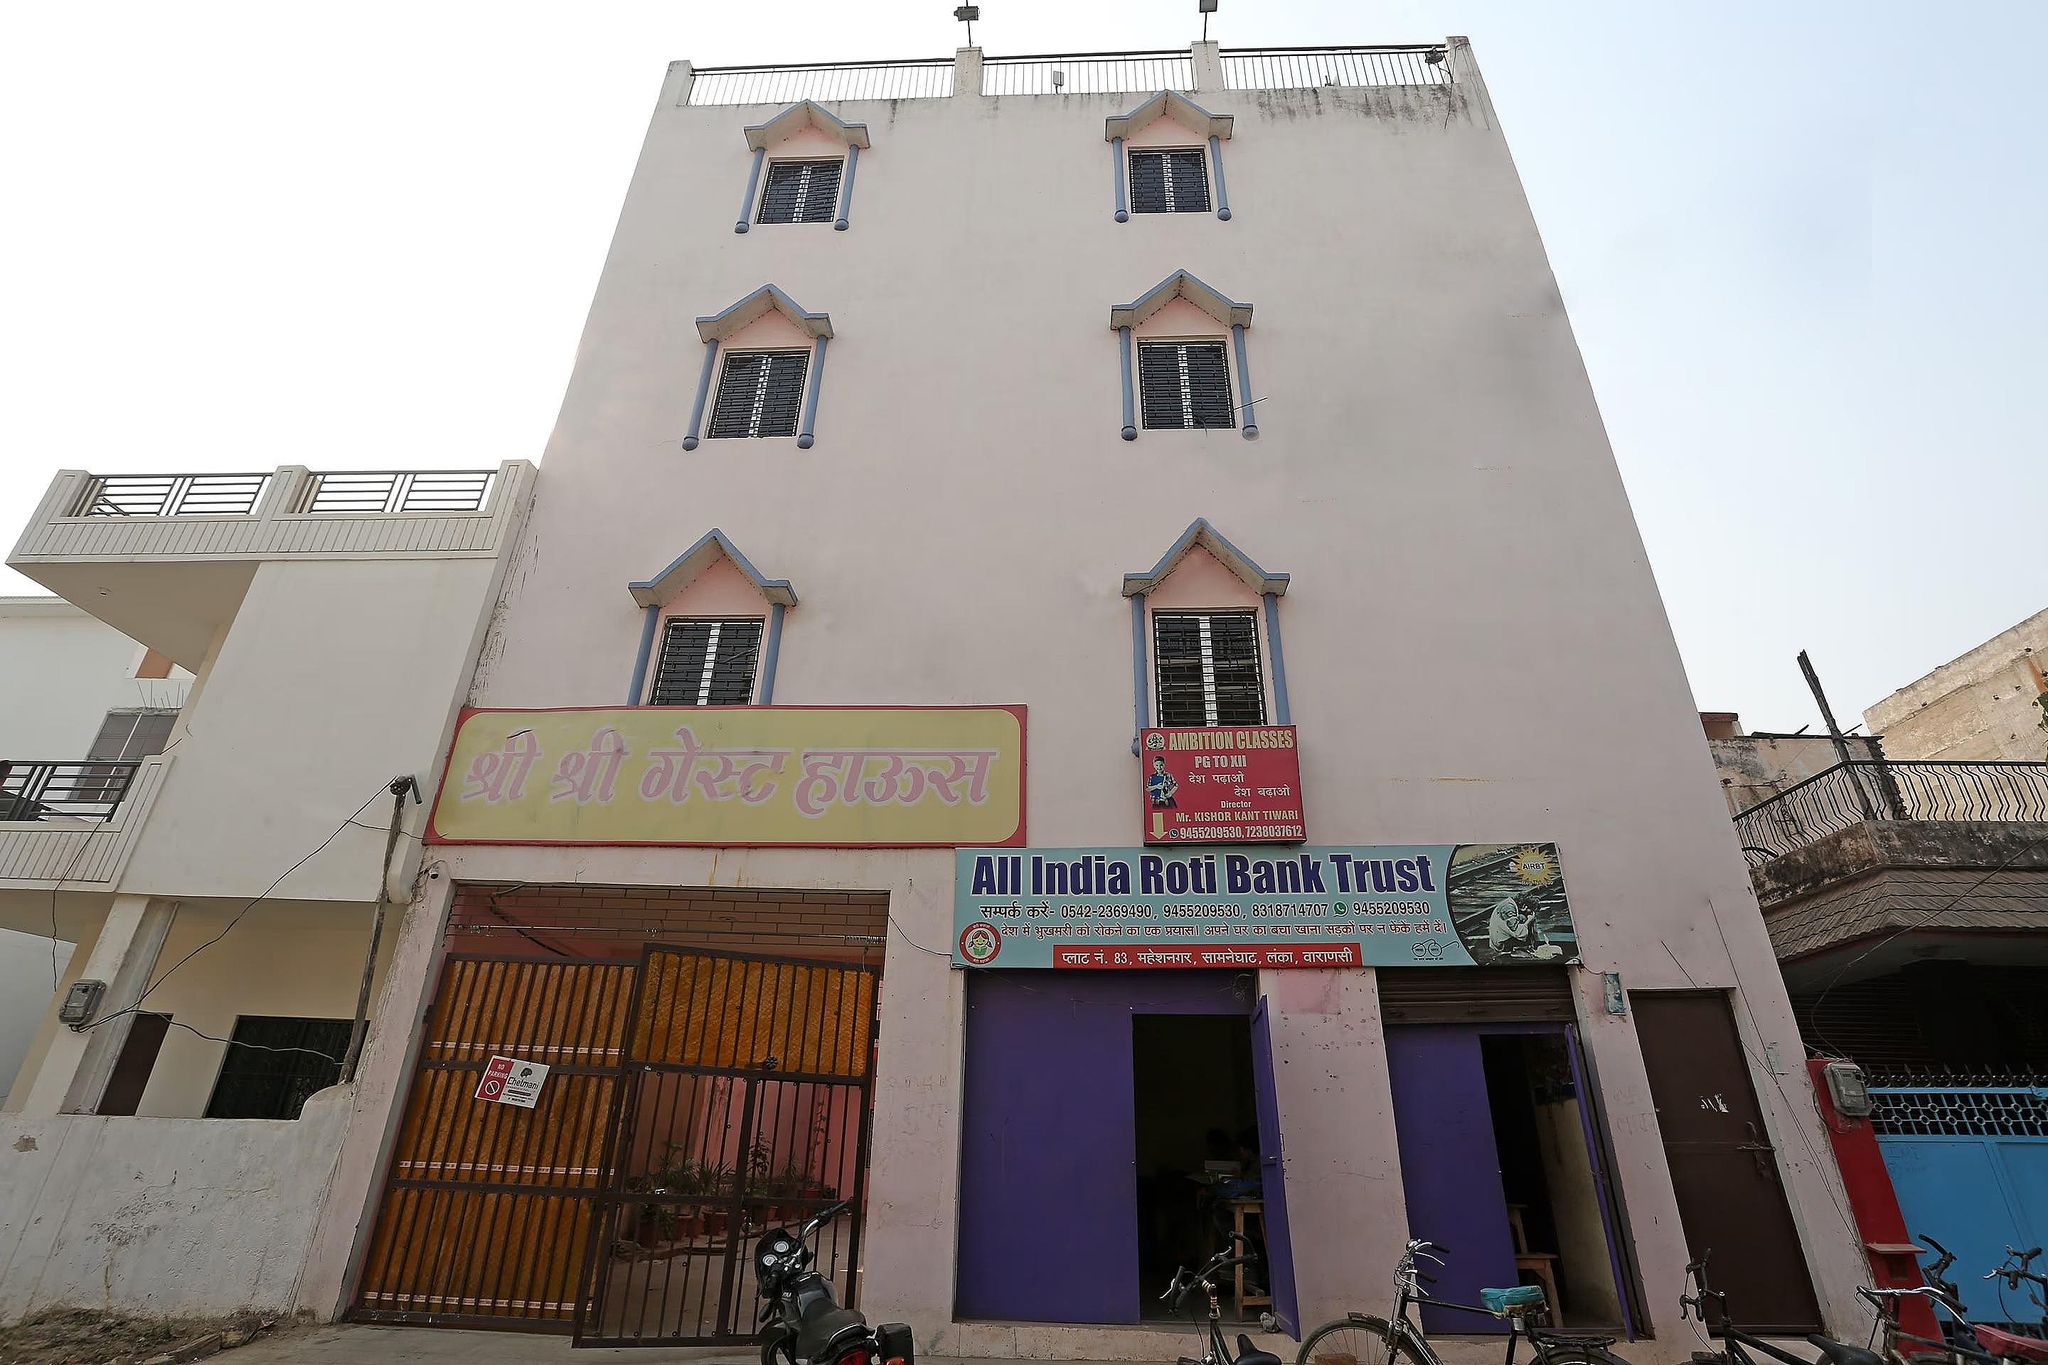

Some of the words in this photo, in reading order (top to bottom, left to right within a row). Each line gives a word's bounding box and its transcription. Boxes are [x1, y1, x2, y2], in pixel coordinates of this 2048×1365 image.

[1168, 732, 1233, 750] AMBITION
[1236, 730, 1294, 749] CLASSES
[461, 728, 541, 802] श्री
[551, 728, 630, 803] श्री
[638, 727, 786, 805] गेस्ट
[1195, 756, 1211, 768] PG
[1213, 756, 1229, 768] TO
[1231, 755, 1246, 767] XII
[1188, 772, 1205, 784] देश
[1234, 786, 1251, 797] देश
[1221, 800, 1252, 808] Director
[1176, 812, 1191, 822] Mr.
[1195, 812, 1232, 822] KISHOR
[1234, 811, 1259, 821] KANT
[1262, 810, 1298, 820] TIWARI
[970, 854, 1022, 896] All
[1030, 854, 1131, 896] India
[1139, 853, 1217, 896] Roti
[1225, 853, 1327, 895] Bank
[1329, 853, 1435, 894] Trust
[980, 900, 1021, 920] सम्पर्क
[1252, 903, 1328, 918] 8318714707
[1353, 901, 1431, 916] 9455209530
[1001, 924, 1019, 937] देश
[1022, 923, 1030, 936] में
[1076, 924, 1090, 937] को
[1094, 923, 1122, 936] रोकने
[1126, 925, 1140, 936] का
[1144, 925, 1161, 936] एक
[1205, 923, 1229, 935] अपने
[1233, 925, 1249, 935] घर
[1252, 924, 1268, 936] का
[1271, 924, 1291, 935] बचा
[1295, 924, 1322, 935] खाना
[1359, 923, 1374, 935] पर
[1377, 923, 1387, 934] न
[1302, 946, 1353, 963] वाराणसी
[488, 1070, 508, 1080] PARKING
